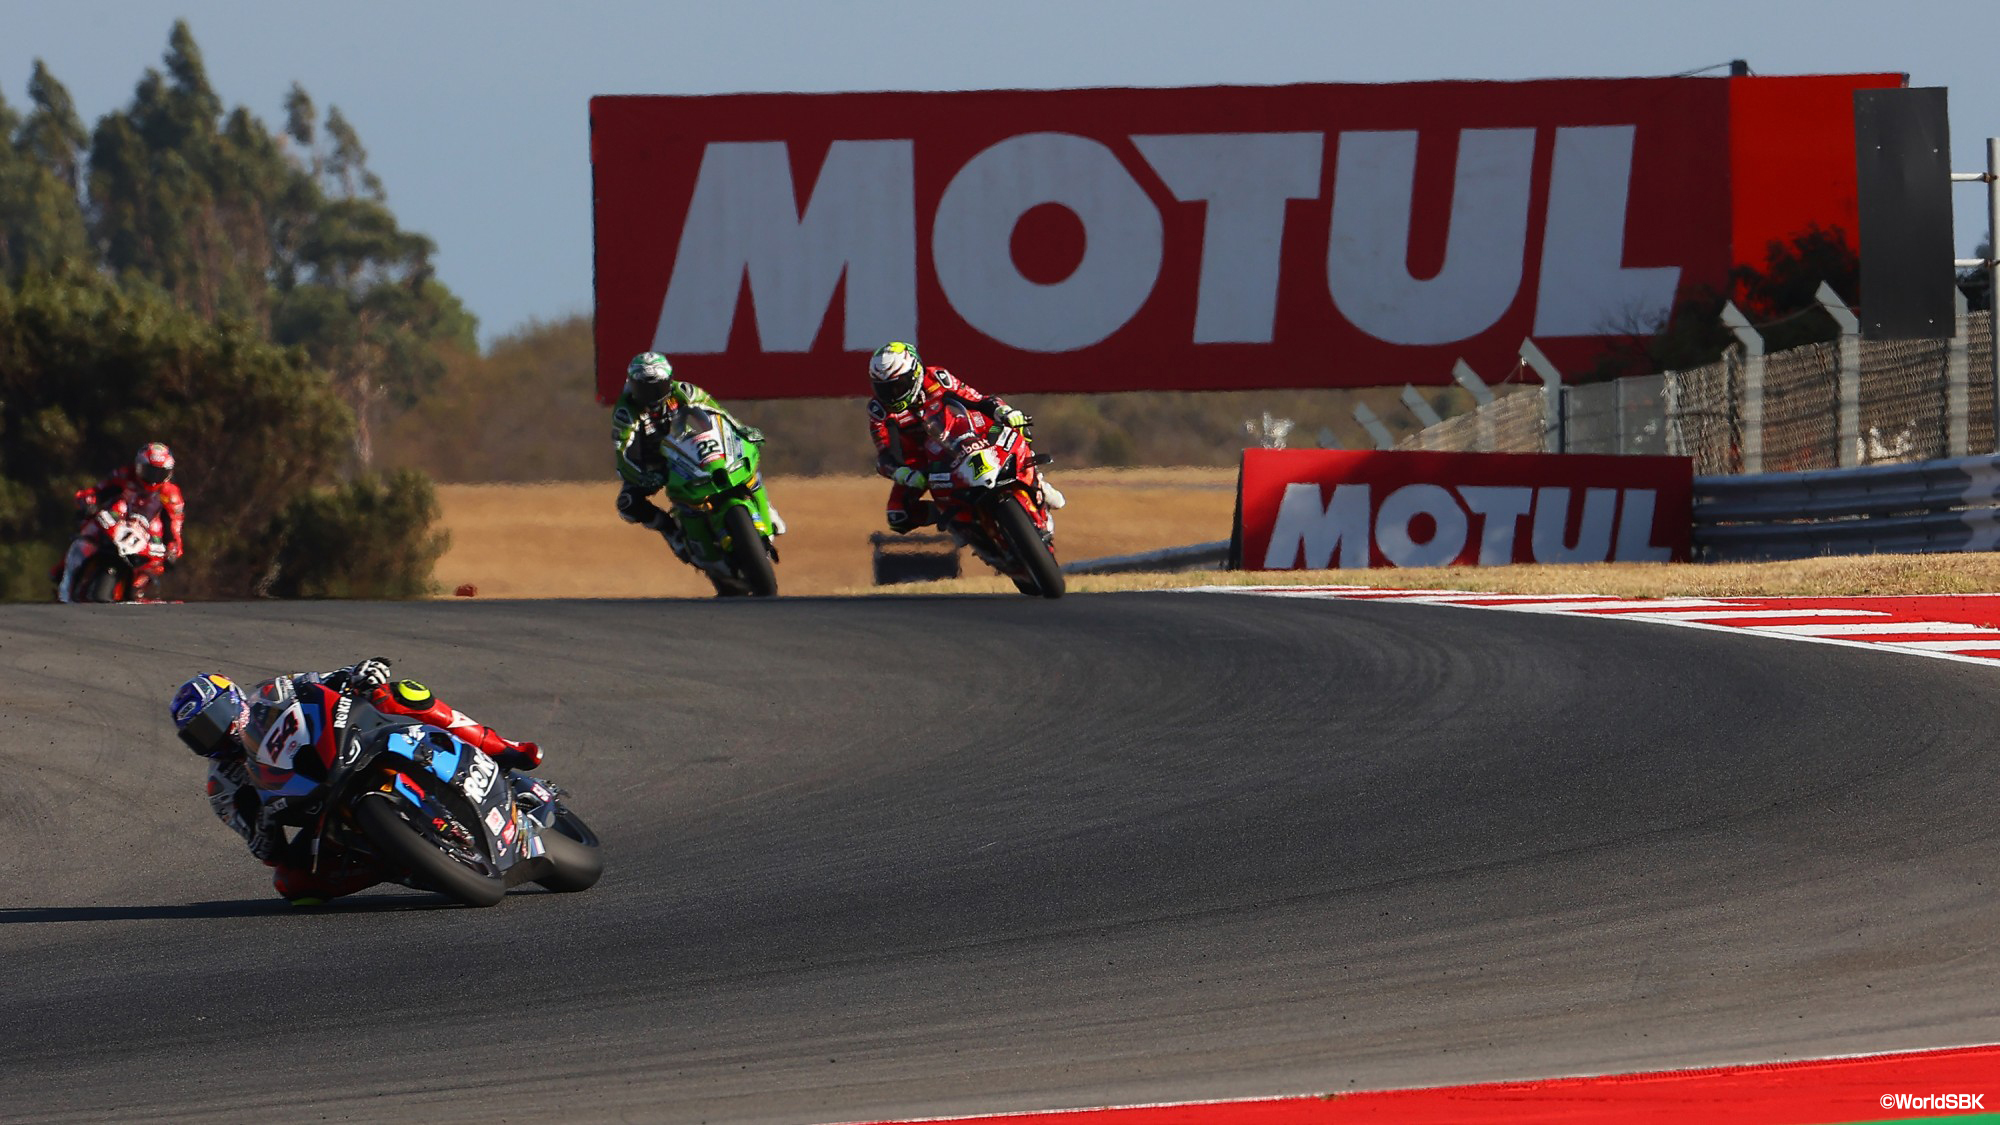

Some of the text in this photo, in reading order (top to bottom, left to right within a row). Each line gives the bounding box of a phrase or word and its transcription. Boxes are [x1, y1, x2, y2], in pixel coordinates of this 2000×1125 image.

[656, 124, 1682, 354] MOTUL
[697, 439, 721, 461] 22
[1264, 482, 1674, 570] MOTUL
[266, 710, 299, 764] 54
